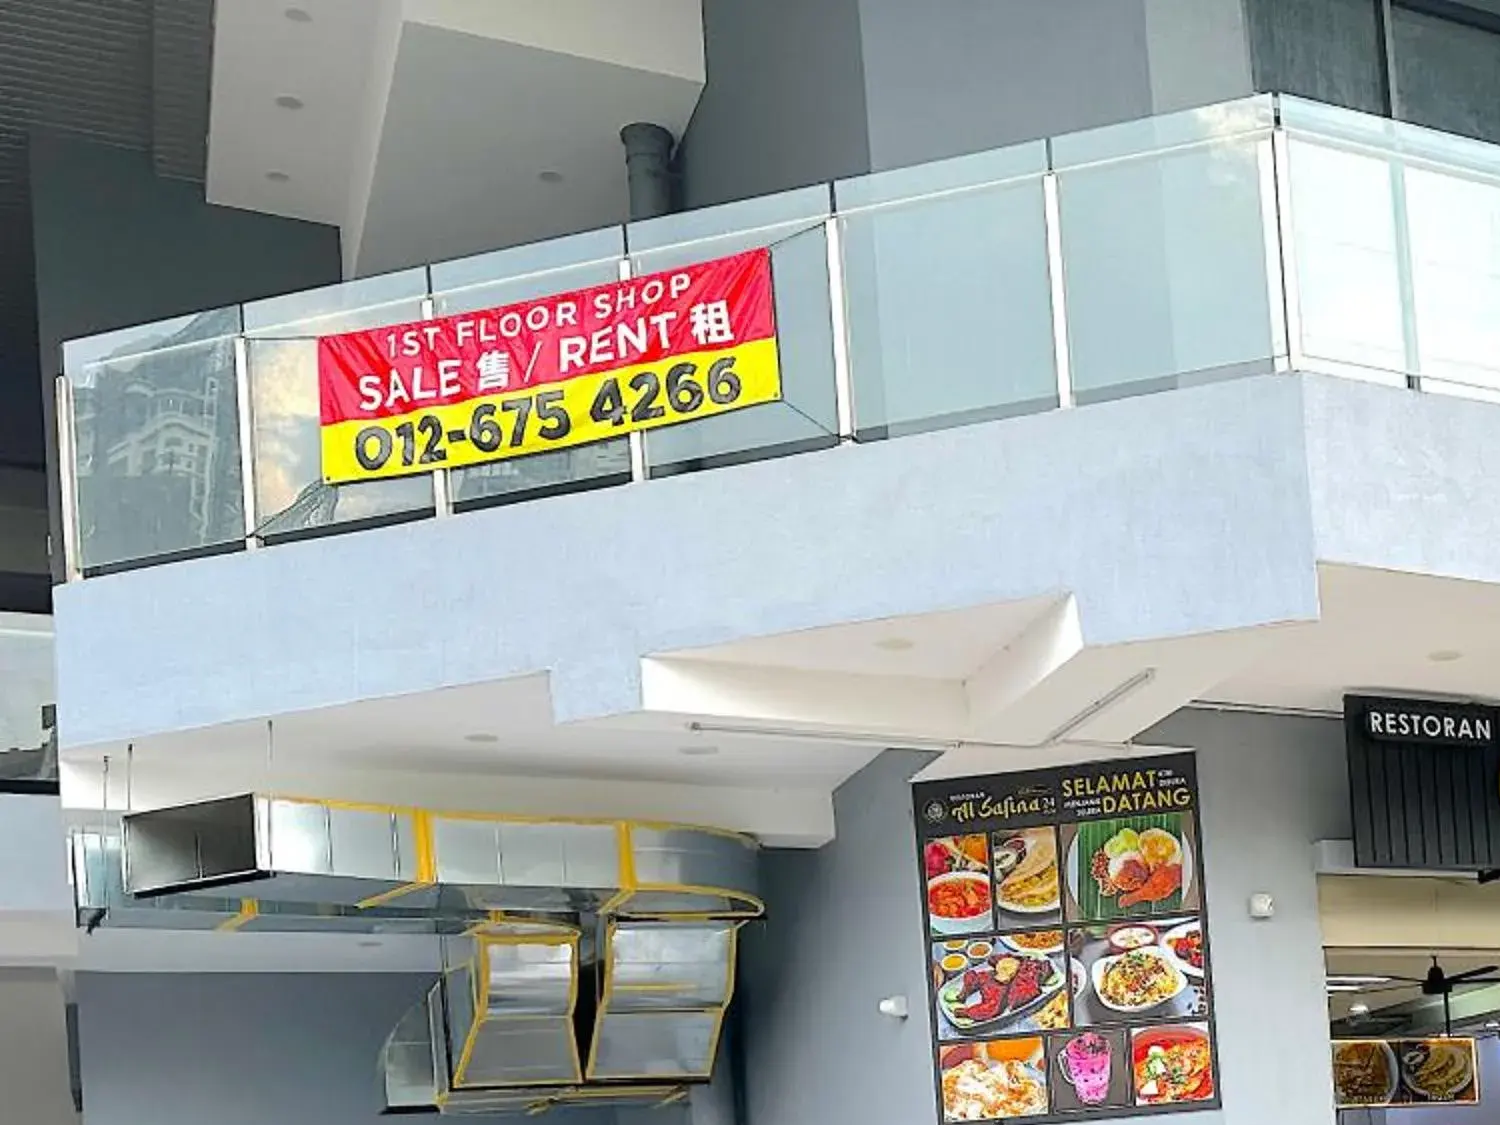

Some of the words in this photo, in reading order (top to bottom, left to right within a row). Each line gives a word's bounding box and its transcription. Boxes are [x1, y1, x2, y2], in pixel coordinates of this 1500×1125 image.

[386, 326, 440, 358] 1ST
[457, 300, 577, 347] FLOOR
[594, 273, 692, 318] SHOP
[358, 359, 461, 411] SALE
[476, 350, 510, 392] 售
[559, 312, 677, 372] RENT
[691, 300, 734, 345] 租
[355, 391, 571, 470] 012-675
[589, 357, 741, 427] 4266
[1370, 711, 1491, 740] RESTORAN
[1062, 770, 1157, 797] SELAMAT
[951, 800, 975, 822] Al
[978, 796, 1040, 819] Safina
[1102, 788, 1190, 814] DATANG
